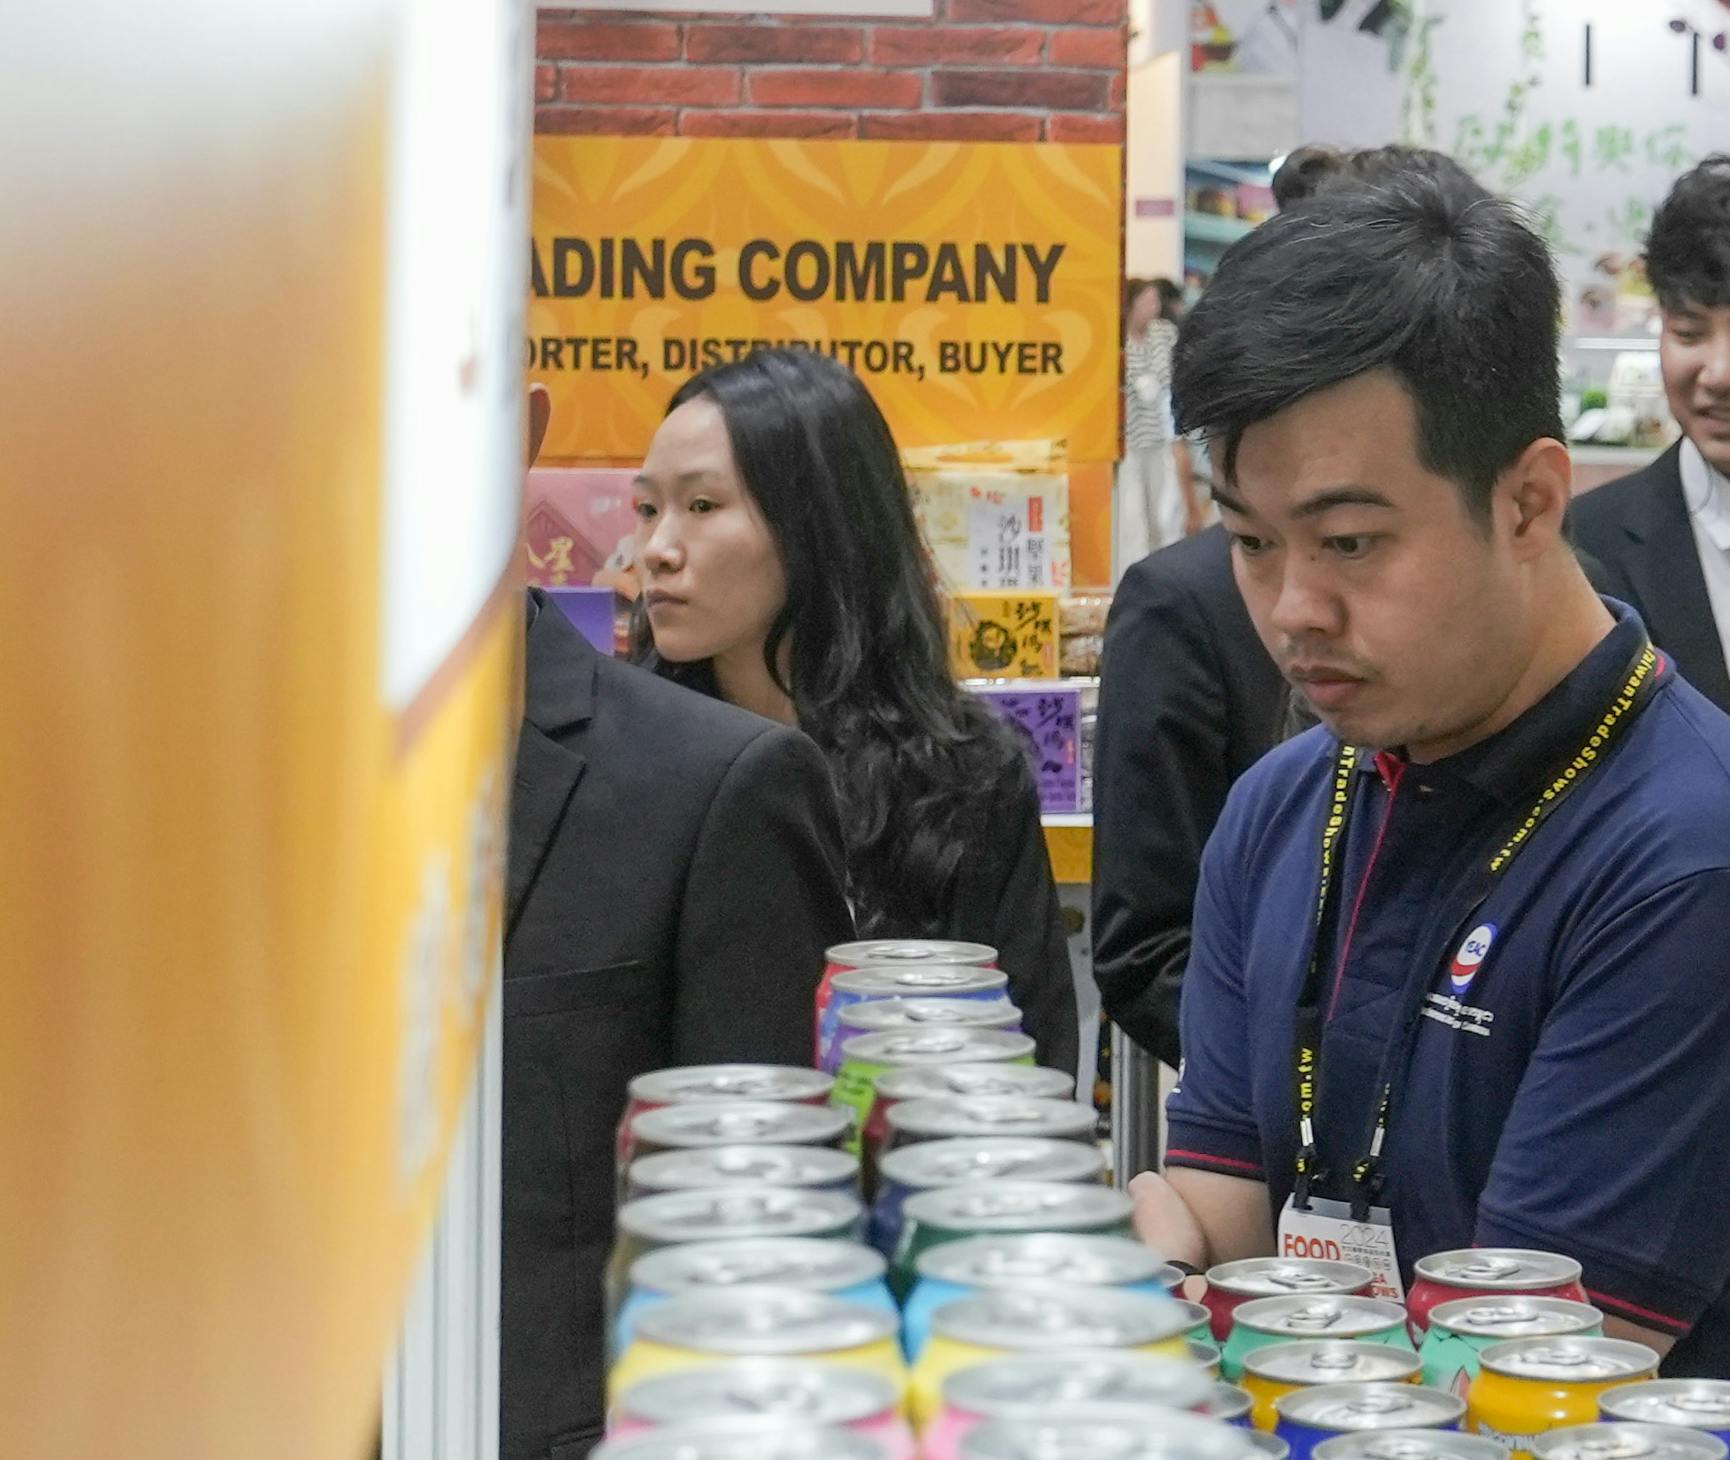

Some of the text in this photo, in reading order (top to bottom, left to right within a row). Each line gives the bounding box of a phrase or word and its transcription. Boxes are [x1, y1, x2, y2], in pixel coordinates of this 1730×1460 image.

[738, 241, 1066, 304] COMPANY
[663, 338, 926, 381] DISTUTOR,
[938, 342, 1064, 376] BUYER
[1284, 1233, 1340, 1260] FOOD
[1340, 1224, 1390, 1249] 2024
